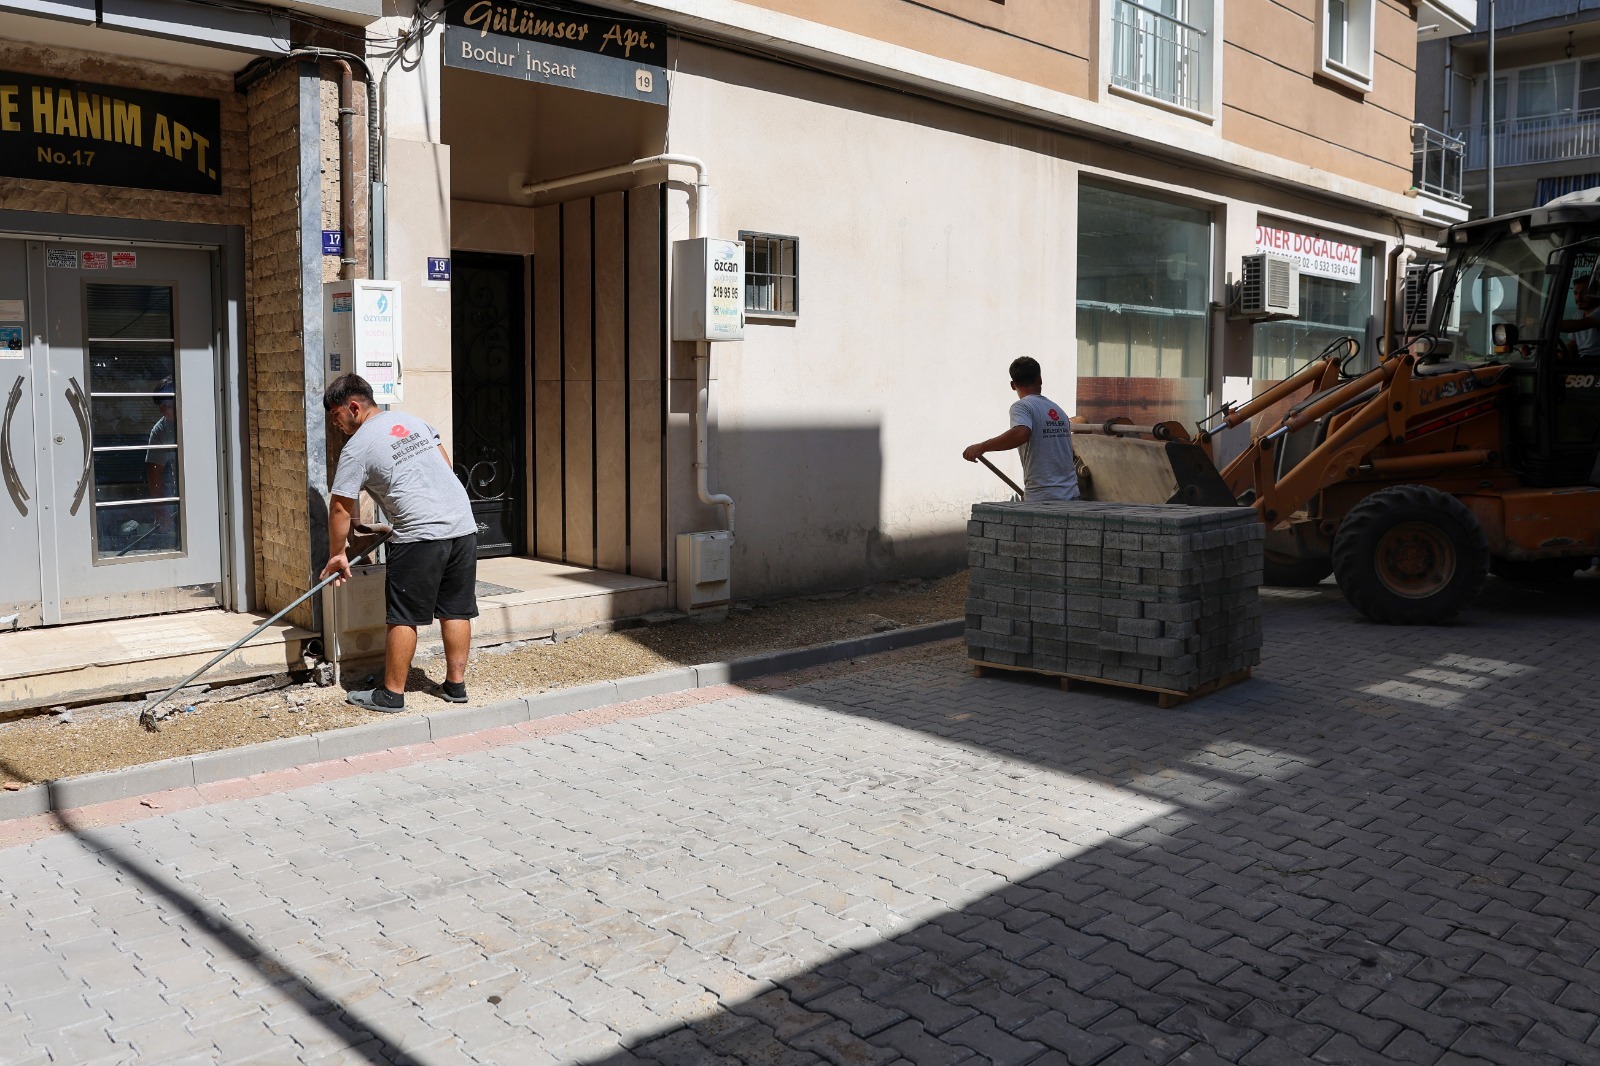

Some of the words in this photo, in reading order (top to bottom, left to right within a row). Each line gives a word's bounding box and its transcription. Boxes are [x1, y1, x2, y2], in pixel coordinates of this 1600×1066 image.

[463, 1, 588, 40] Gülümser
[599, 24, 655, 57] Apt.
[461, 41, 515, 67] Bodur
[526, 50, 577, 79] İnşaat
[637, 74, 650, 88] 19
[32, 85, 142, 147] HANIM
[152, 112, 216, 180] APT.
[37, 146, 95, 167] No.17
[329, 234, 341, 245] 17
[434, 260, 445, 272] 19
[714, 259, 738, 272] özcan
[1319, 261, 1330, 272] 532
[1331, 263, 1341, 274] 139
[713, 285, 723, 298] 219
[723, 286, 731, 299] 95
[363, 313, 392, 323] ÖZYURT
[1565, 374, 1595, 388] 580
[382, 383, 394, 394] 187
[391, 432, 421, 450] EFELER
